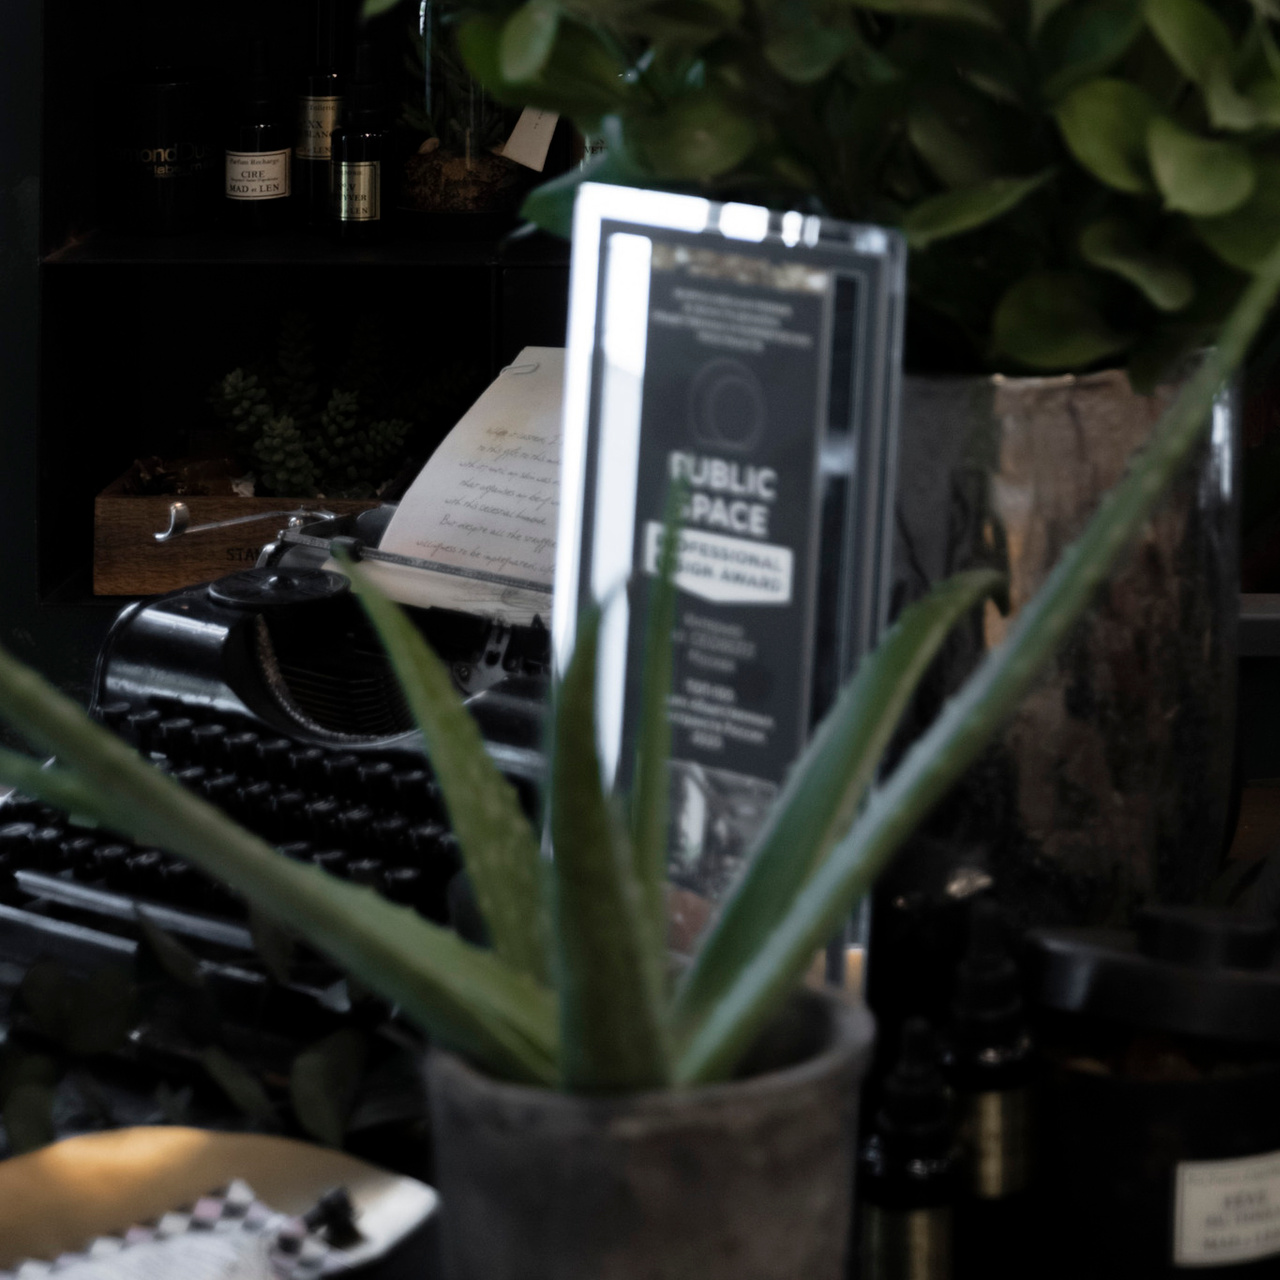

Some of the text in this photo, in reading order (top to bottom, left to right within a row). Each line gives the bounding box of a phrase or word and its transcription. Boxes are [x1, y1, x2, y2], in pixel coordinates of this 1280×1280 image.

[241, 170, 265, 179] CIRE
[229, 183, 280, 193] MAD LEN
[680, 493, 770, 539] PACE
